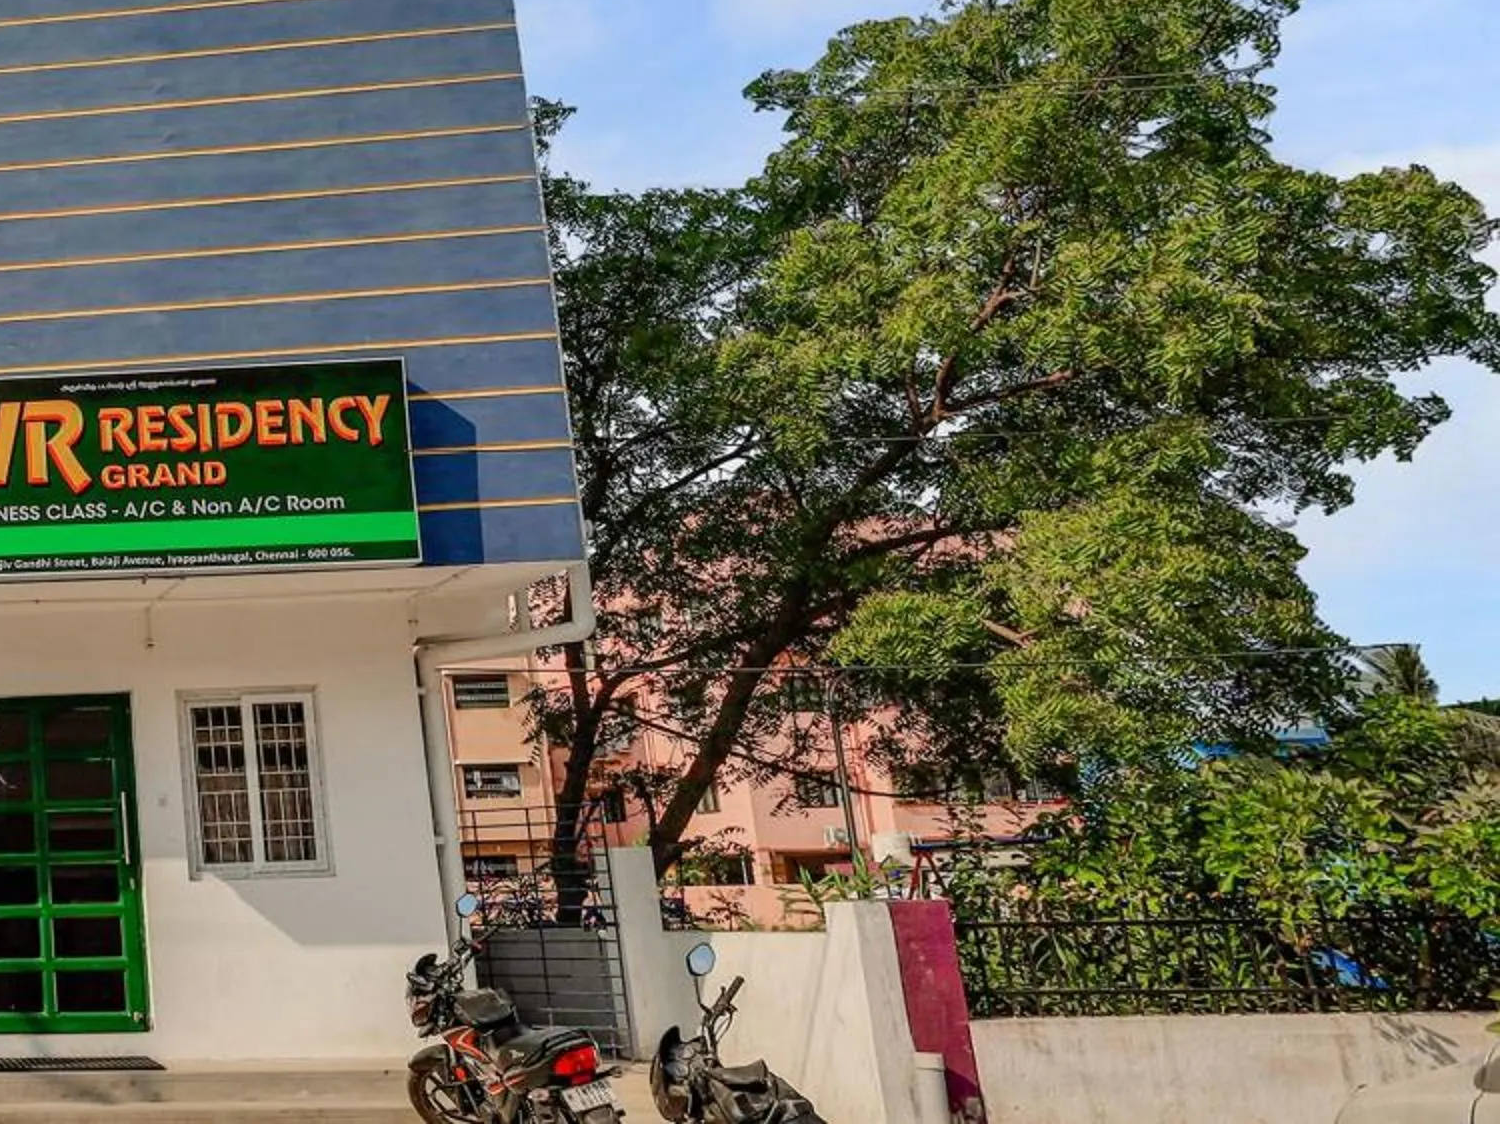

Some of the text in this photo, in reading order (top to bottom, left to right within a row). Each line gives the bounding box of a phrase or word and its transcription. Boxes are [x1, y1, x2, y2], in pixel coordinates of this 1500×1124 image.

[97, 394, 391, 458] RESIDENCY
[101, 461, 228, 490] GRAND
[46, 502, 108, 521] CLASS
[123, 499, 166, 519] A/C
[171, 499, 186, 516] &
[192, 498, 232, 515] Non
[238, 495, 281, 514] A/C
[286, 494, 346, 511] Room
[15, 557, 51, 570] Gandhi
[53, 557, 89, 569] Street,
[91, 555, 121, 568] Balaji
[122, 554, 166, 566] Avenue,
[167, 551, 253, 566] Iyappanthangal,
[255, 549, 299, 560] Chennai
[307, 548, 328, 559] 600
